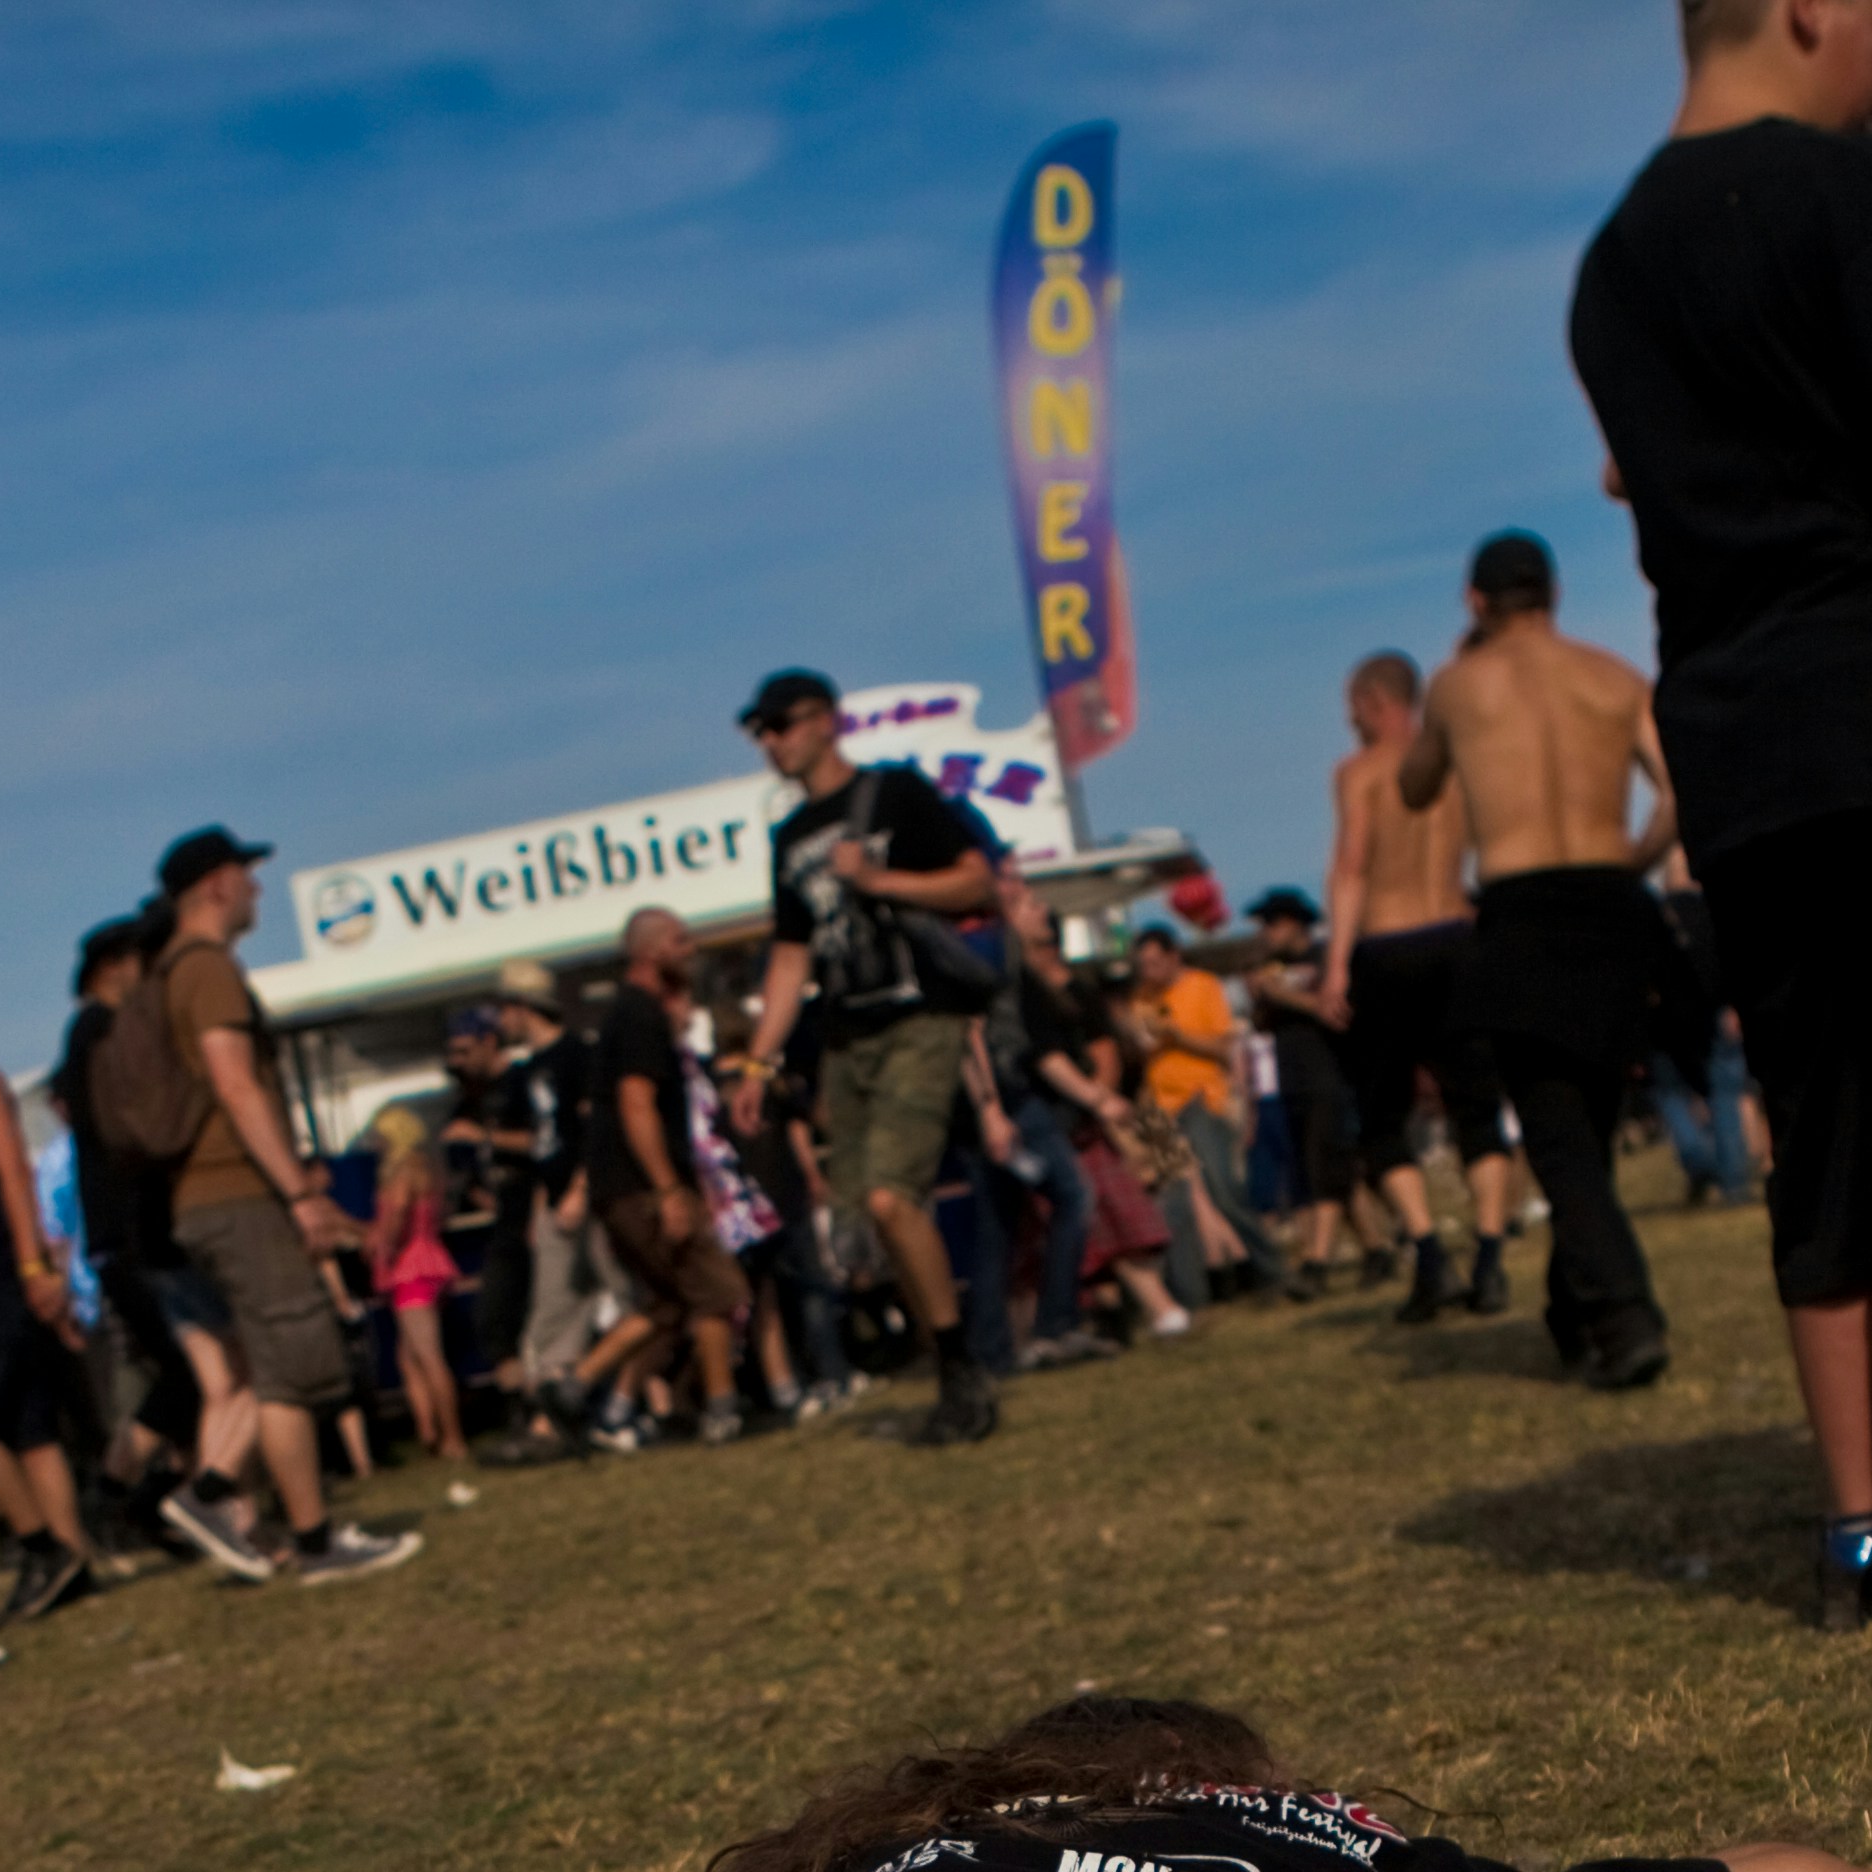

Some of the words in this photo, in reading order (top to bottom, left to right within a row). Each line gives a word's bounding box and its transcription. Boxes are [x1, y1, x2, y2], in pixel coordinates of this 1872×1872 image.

[1030, 163, 1096, 664] DÖNER
[390, 814, 746, 926] Weißbier
[1281, 1794, 1383, 1864] Festival
